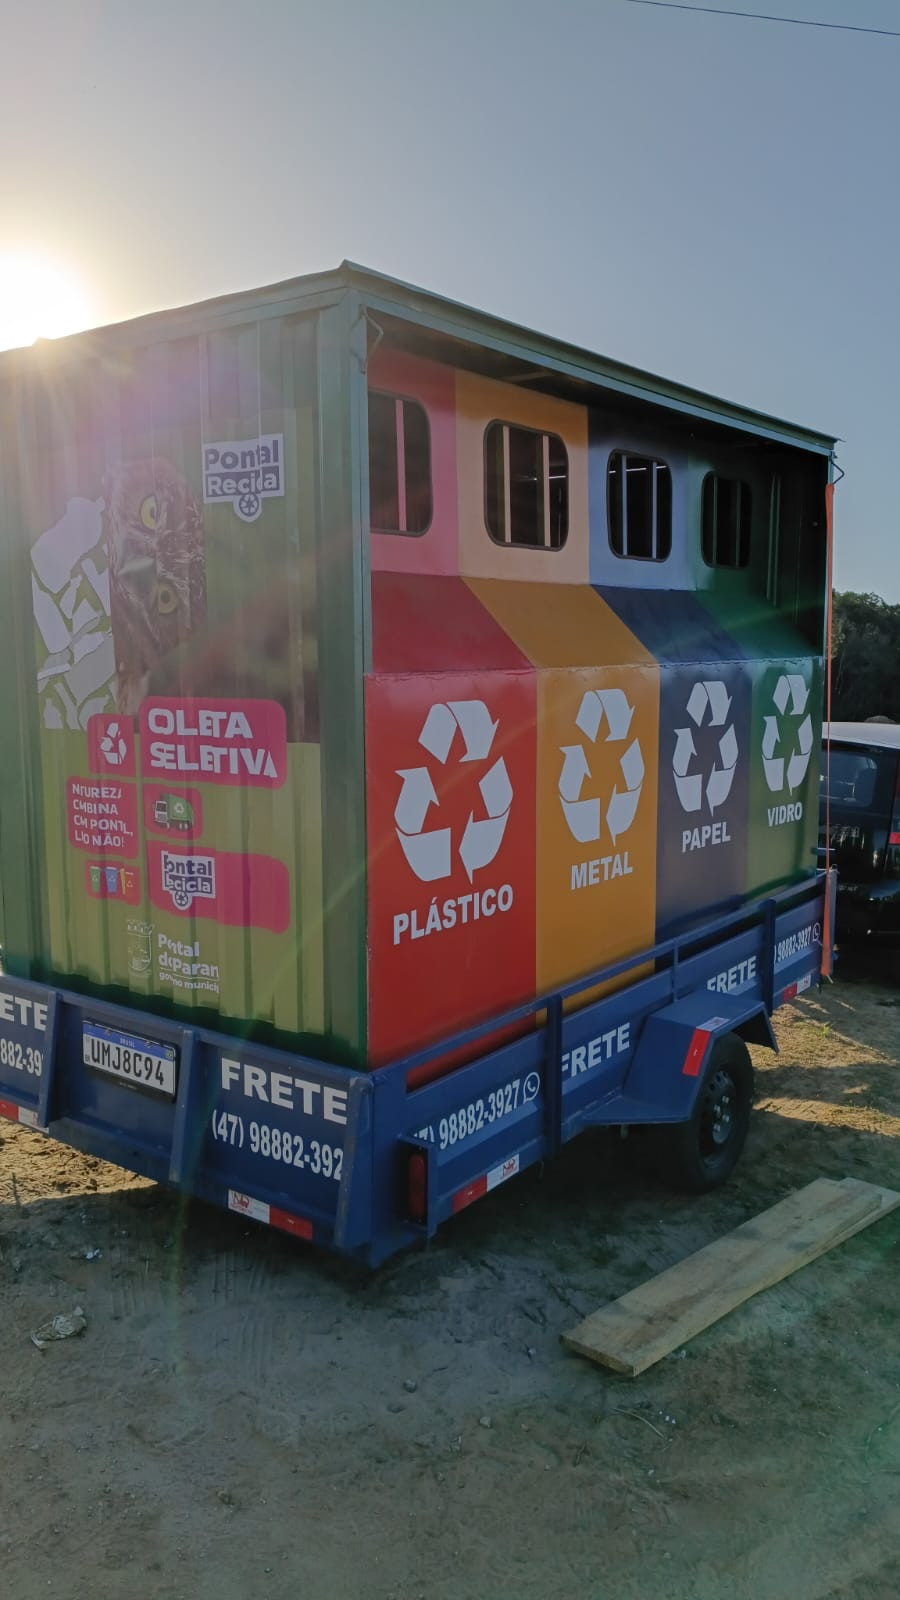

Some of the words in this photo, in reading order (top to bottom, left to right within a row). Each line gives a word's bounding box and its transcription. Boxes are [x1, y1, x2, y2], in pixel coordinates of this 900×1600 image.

[205, 440, 279, 472] Pontal
[767, 801, 803, 828] VIDRO
[682, 822, 731, 854] PAPEL
[570, 851, 633, 891] METAL
[392, 884, 513, 946] PLÁSTICO
[0, 1038, 44, 1077] 882-39
[91, 1038, 164, 1086] UMJ8C94
[221, 1057, 348, 1126] FRETE
[439, 1079, 521, 1151] 98882-3927
[212, 1109, 244, 1149] (47)
[250, 1121, 344, 1181] 98882-392
